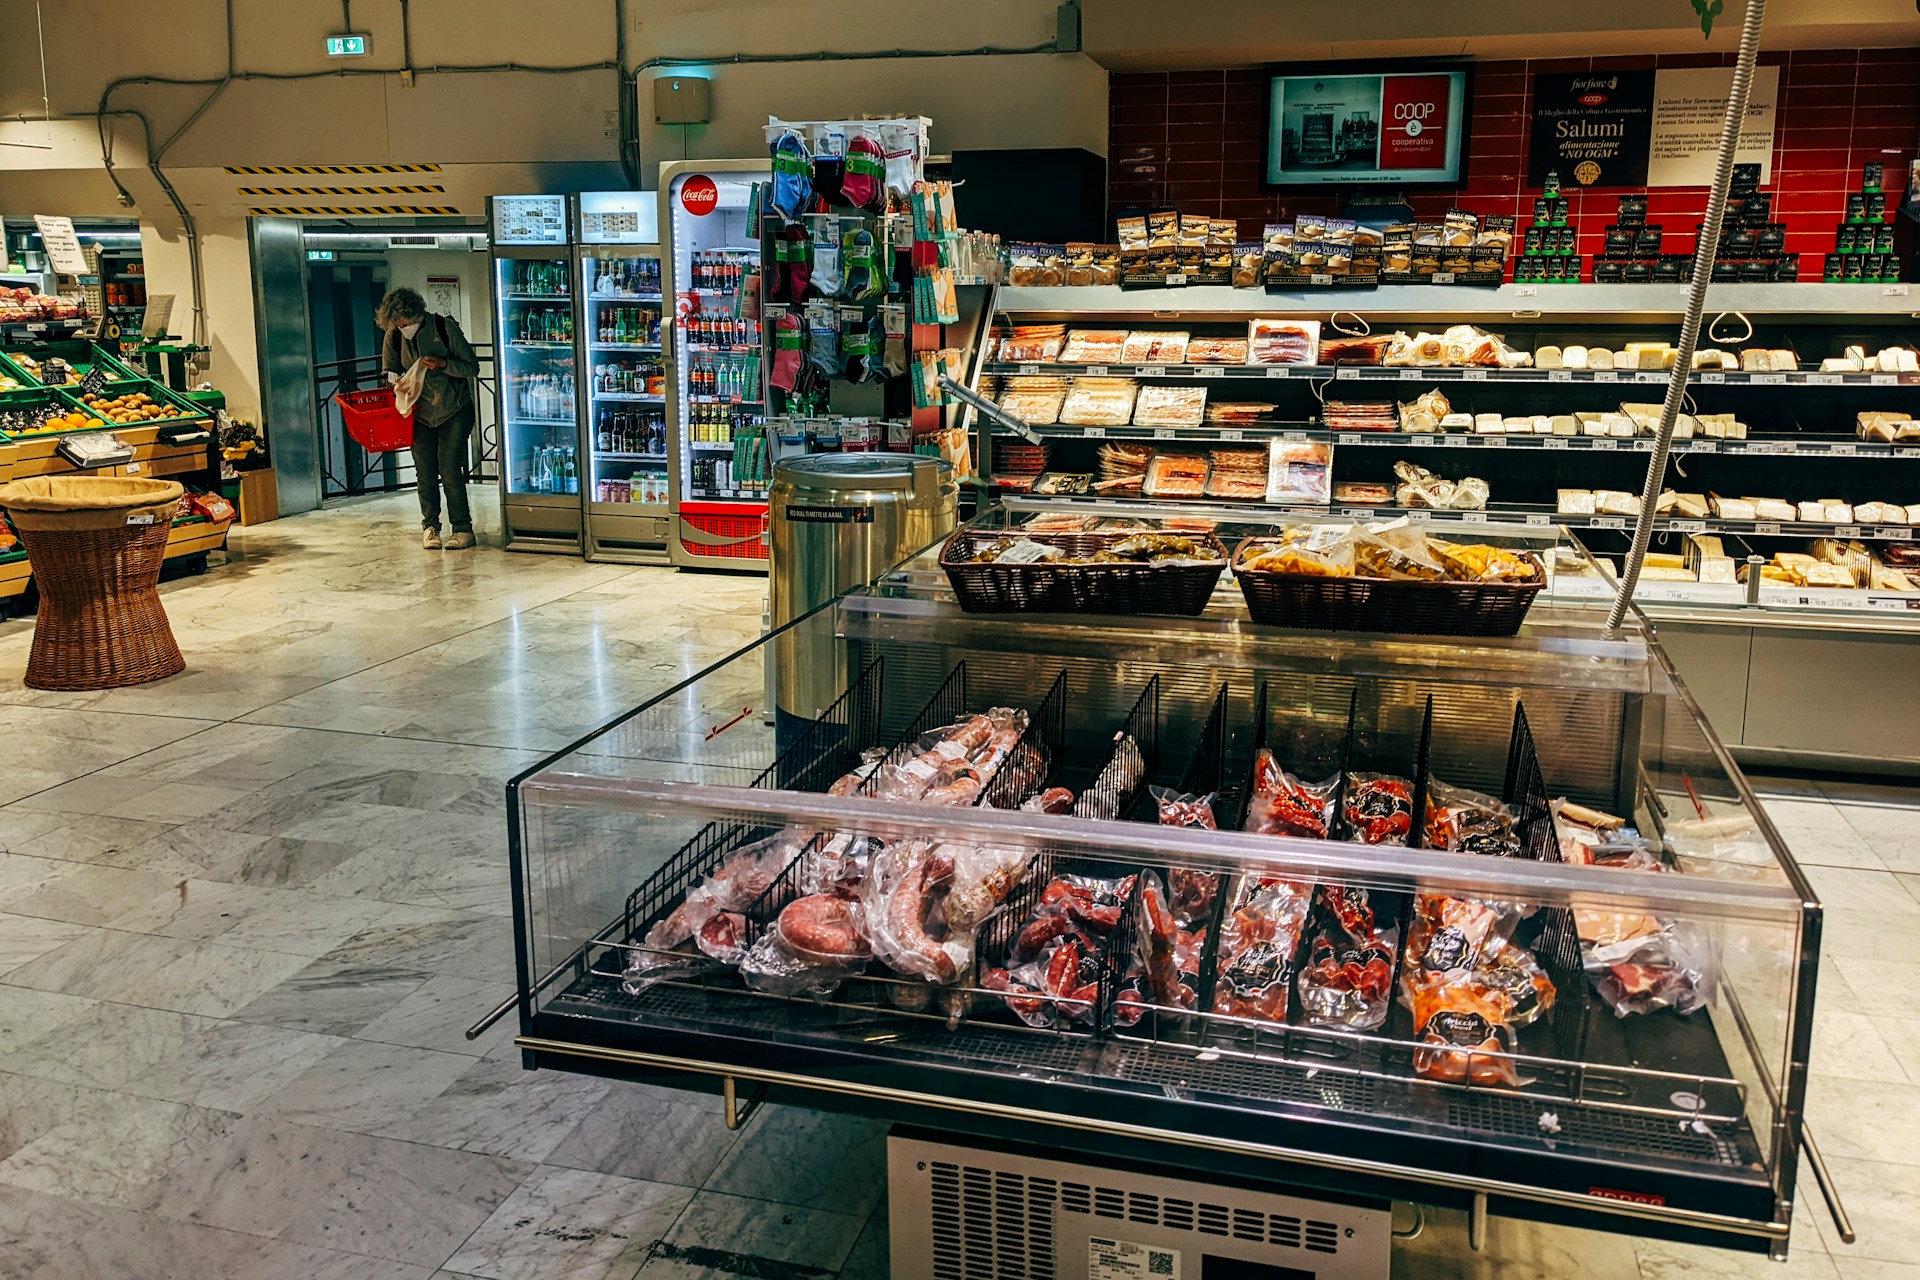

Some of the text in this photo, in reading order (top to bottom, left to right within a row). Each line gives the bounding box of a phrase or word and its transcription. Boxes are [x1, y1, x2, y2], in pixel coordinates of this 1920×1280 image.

[1395, 103, 1435, 120] COOP
[1410, 123, 1416, 133] è
[1556, 119, 1624, 138] Salumi
[1392, 138, 1434, 147] cooperativa
[1559, 140, 1620, 150] alimentazione
[1566, 149, 1612, 158] NO OGM
[778, 159, 786, 171] 3
[846, 159, 854, 172] 3
[776, 337, 784, 348] 3
